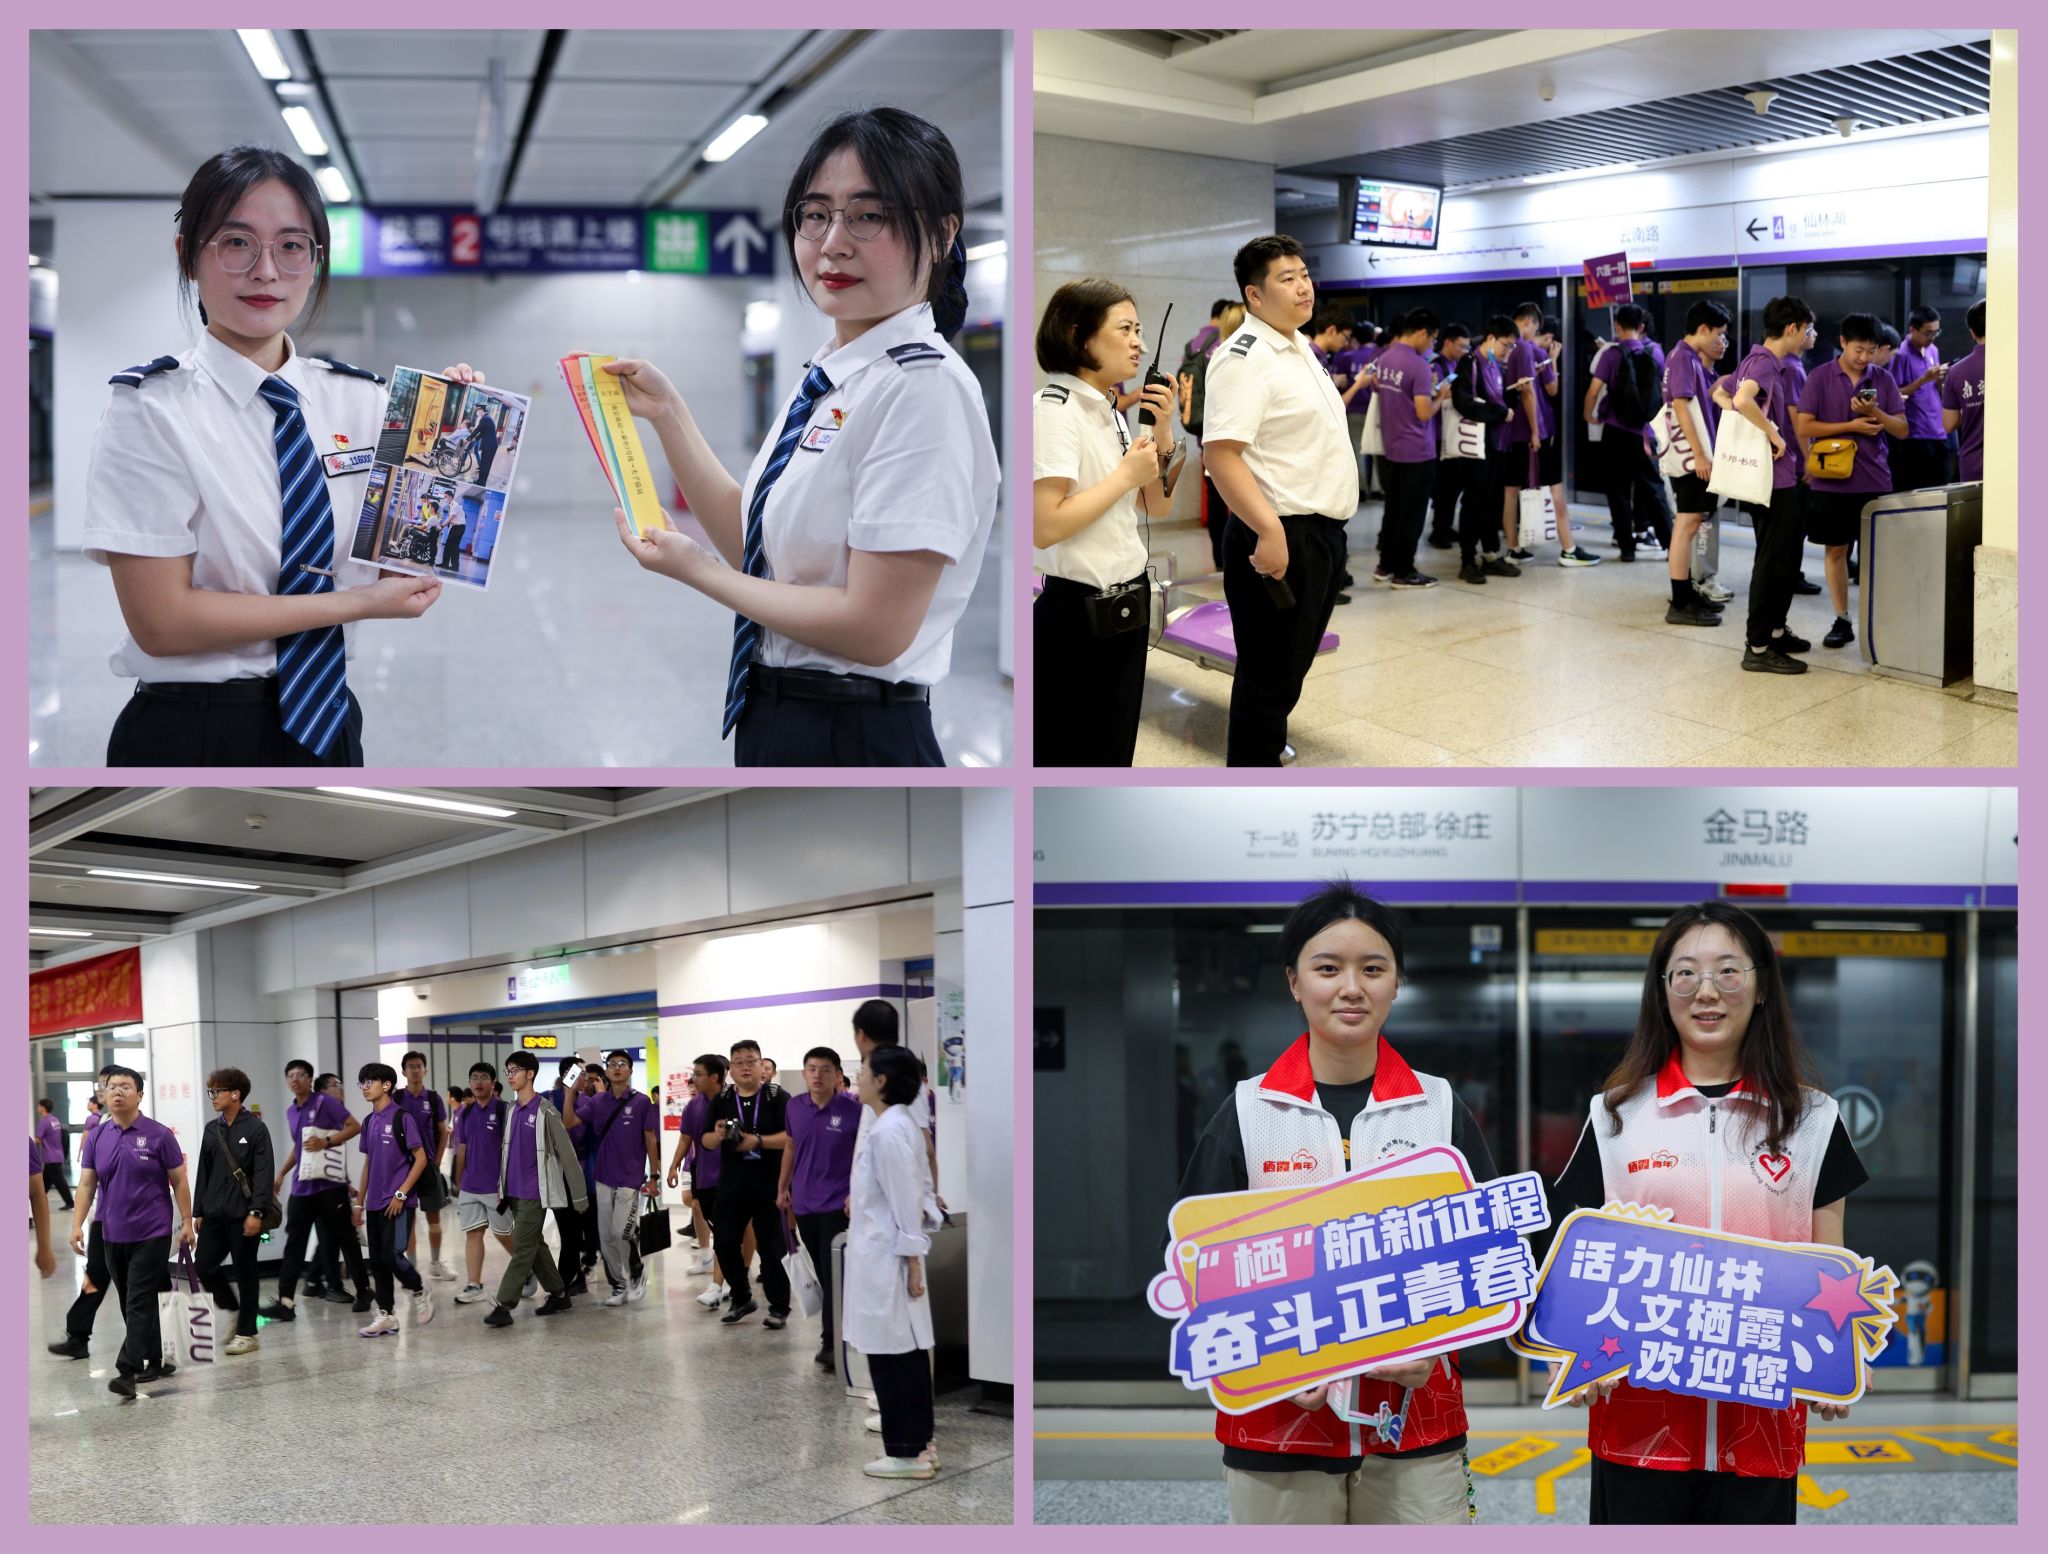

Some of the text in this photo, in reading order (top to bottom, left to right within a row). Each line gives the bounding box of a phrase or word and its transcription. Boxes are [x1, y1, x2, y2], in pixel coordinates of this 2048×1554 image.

[1774, 217, 1784, 238] 4
[1244, 830, 1299, 848] 下一站
[1703, 807, 1808, 845] 金马路
[1720, 852, 1793, 868] JINMALU
[1569, 1239, 1764, 1302] 活力仙林
[188, 1306, 214, 1363] NJU
[1187, 1245, 1532, 1380] 奋斗正青春
[1585, 1287, 1785, 1352] 人文栖霞
[1635, 1340, 1789, 1402] 欢迎您
